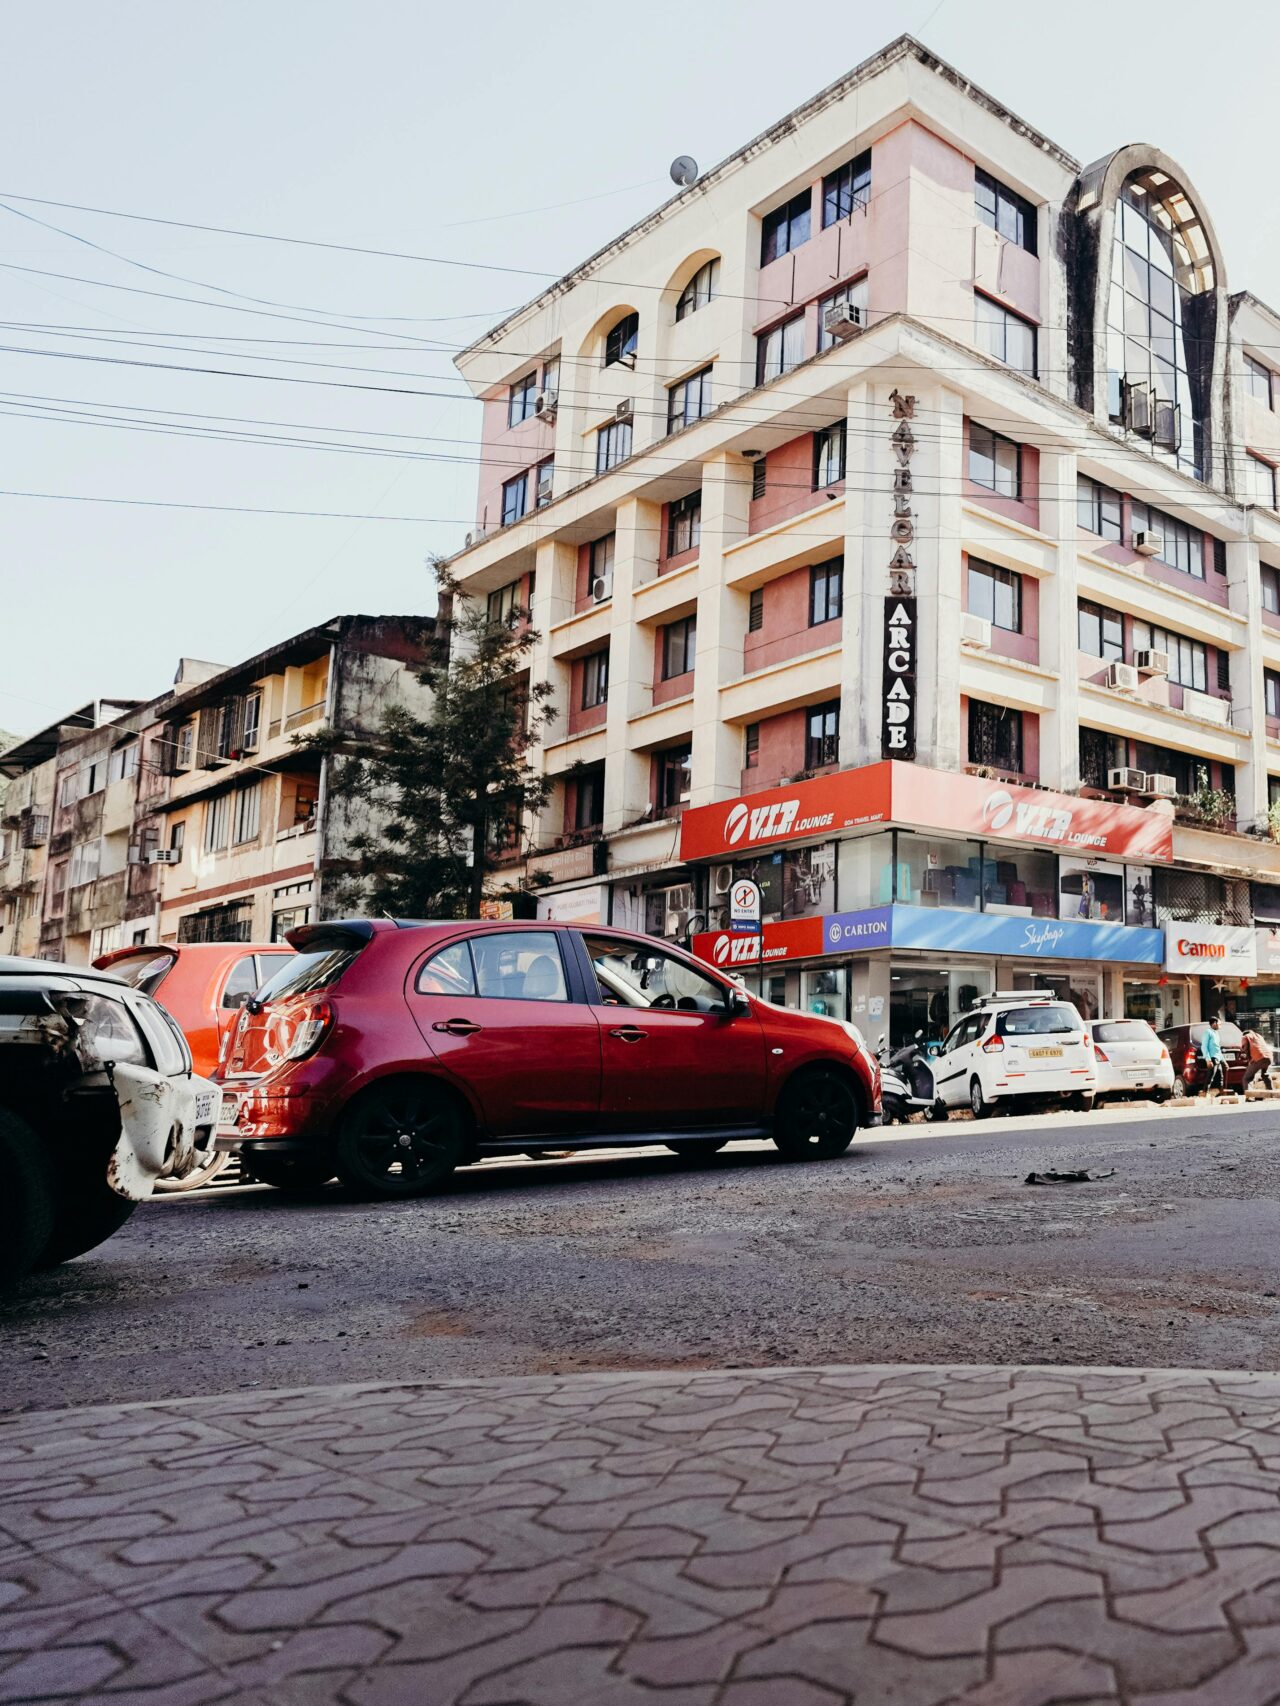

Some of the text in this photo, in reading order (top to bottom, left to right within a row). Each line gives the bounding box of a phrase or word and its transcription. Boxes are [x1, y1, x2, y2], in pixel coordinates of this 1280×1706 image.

[888, 388, 916, 595] NAVELCAR
[886, 603, 912, 749] ARCADE
[794, 812, 835, 832] LOUNGE
[1067, 831, 1107, 847] LOUNGE
[844, 921, 887, 937] CARLTON
[1020, 923, 1065, 953] Skybags
[1177, 938, 1225, 960] Canon
